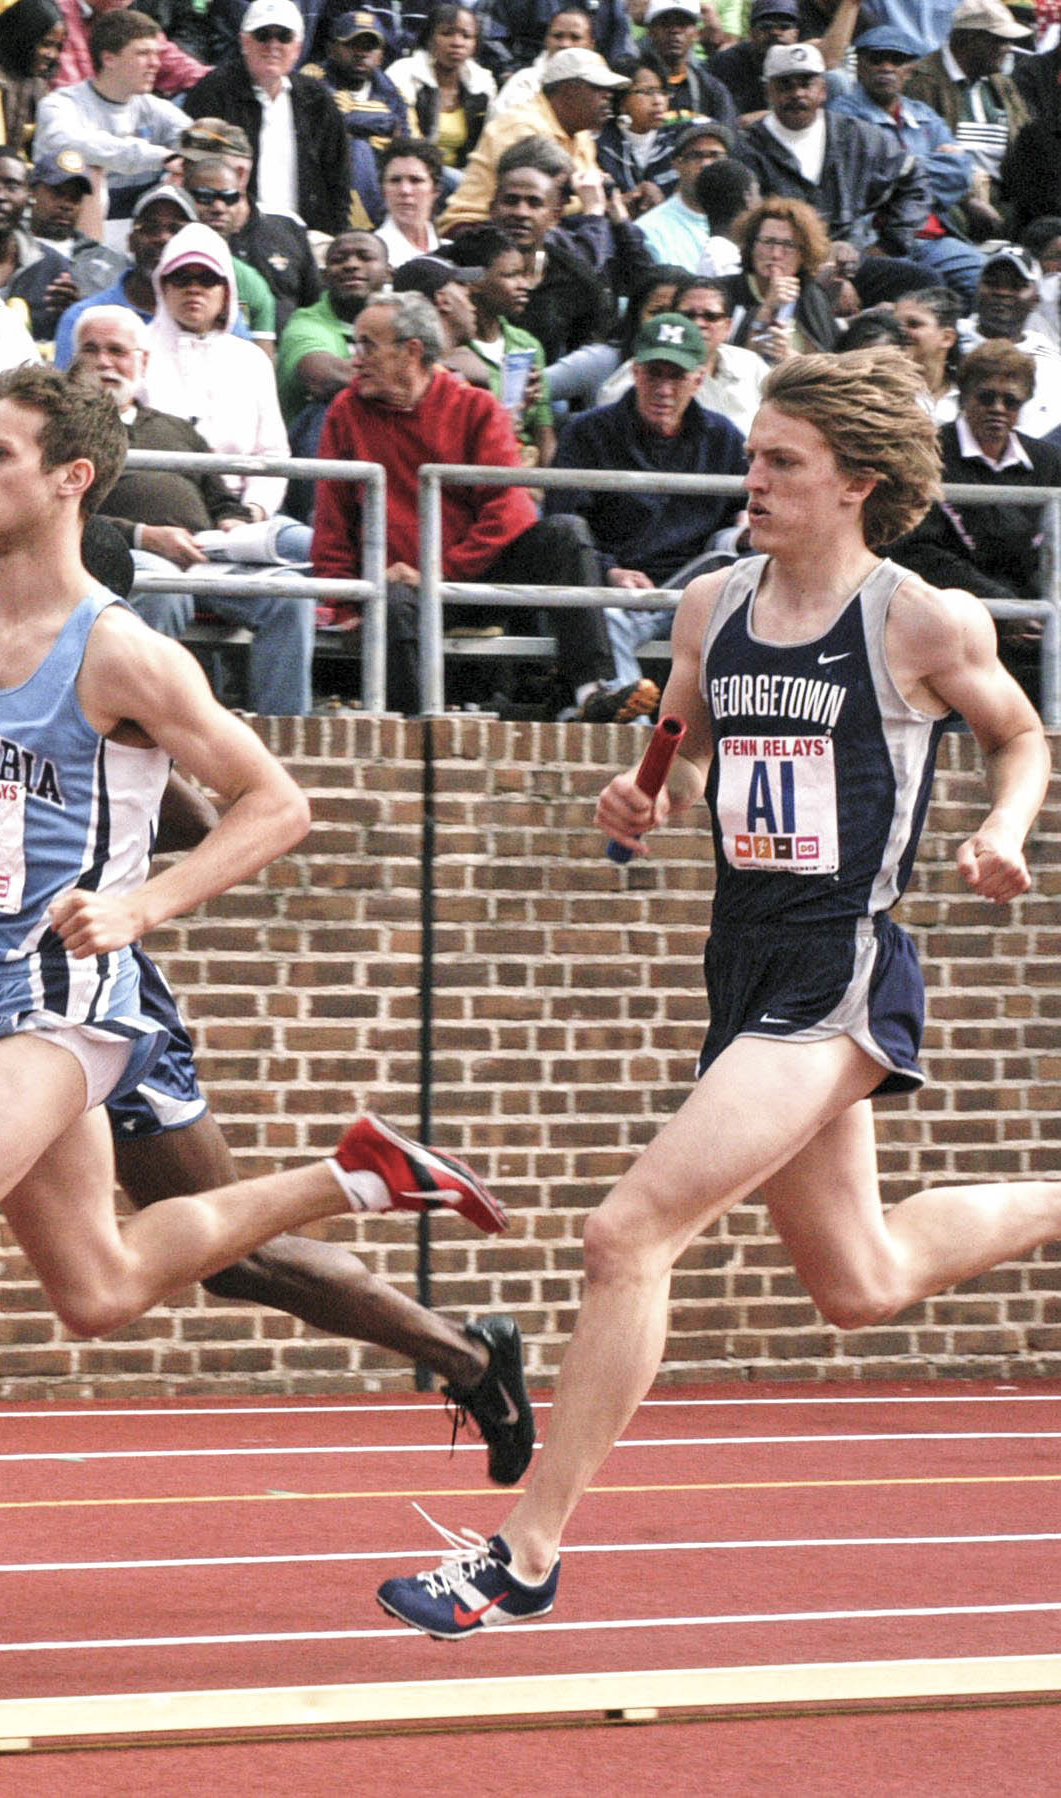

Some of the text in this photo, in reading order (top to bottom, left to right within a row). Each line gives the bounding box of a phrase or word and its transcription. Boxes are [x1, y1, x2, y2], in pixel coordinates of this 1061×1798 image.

[658, 323, 685, 344] M
[711, 674, 847, 728] GEORGETOWN
[724, 739, 824, 756] PENN RELAYS
[747, 761, 796, 833] AI
